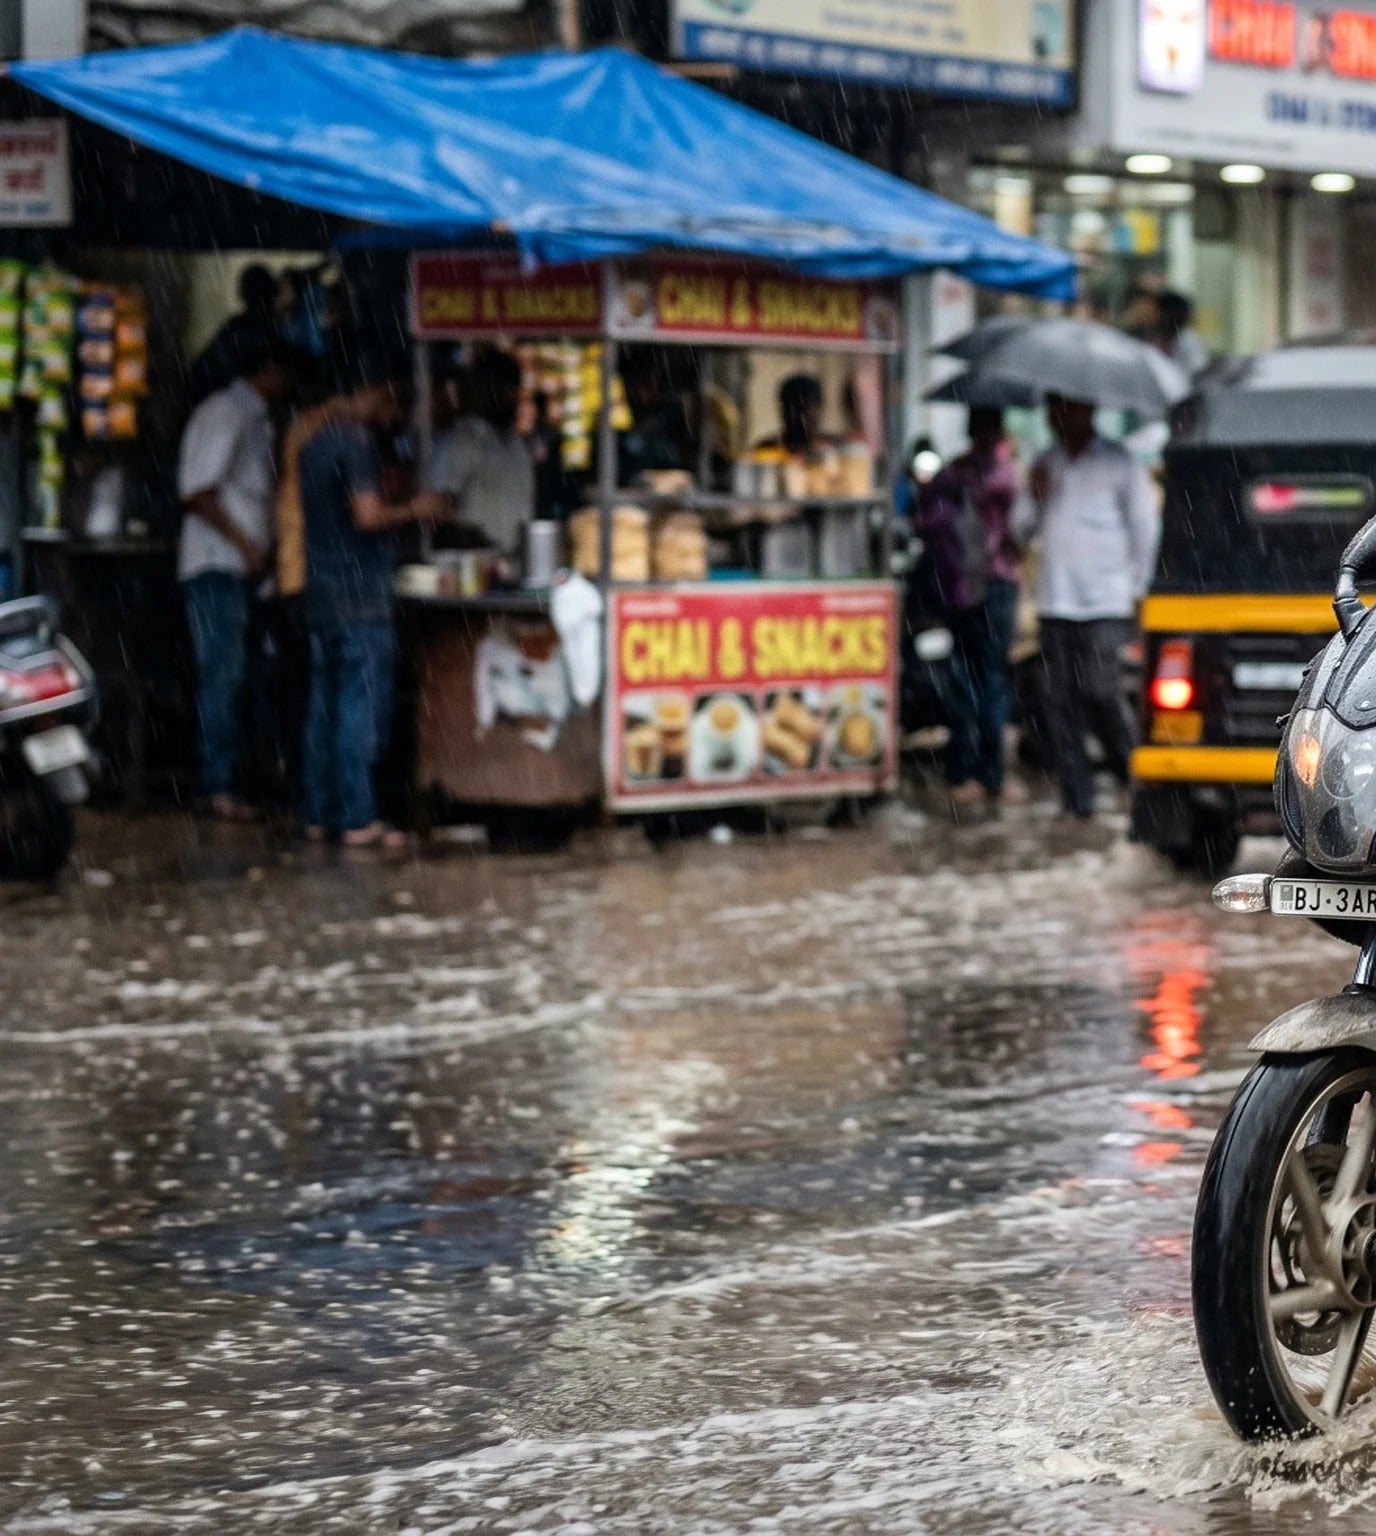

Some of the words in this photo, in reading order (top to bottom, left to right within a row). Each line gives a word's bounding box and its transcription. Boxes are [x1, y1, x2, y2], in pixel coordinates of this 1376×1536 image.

[1208, 0, 1297, 68] CHAI
[657, 271, 726, 325] CHAI
[732, 276, 751, 329] &
[756, 277, 859, 335] SNACKS
[621, 617, 711, 684] CHAI
[717, 614, 746, 680] &
[753, 613, 887, 679] SNACKS
